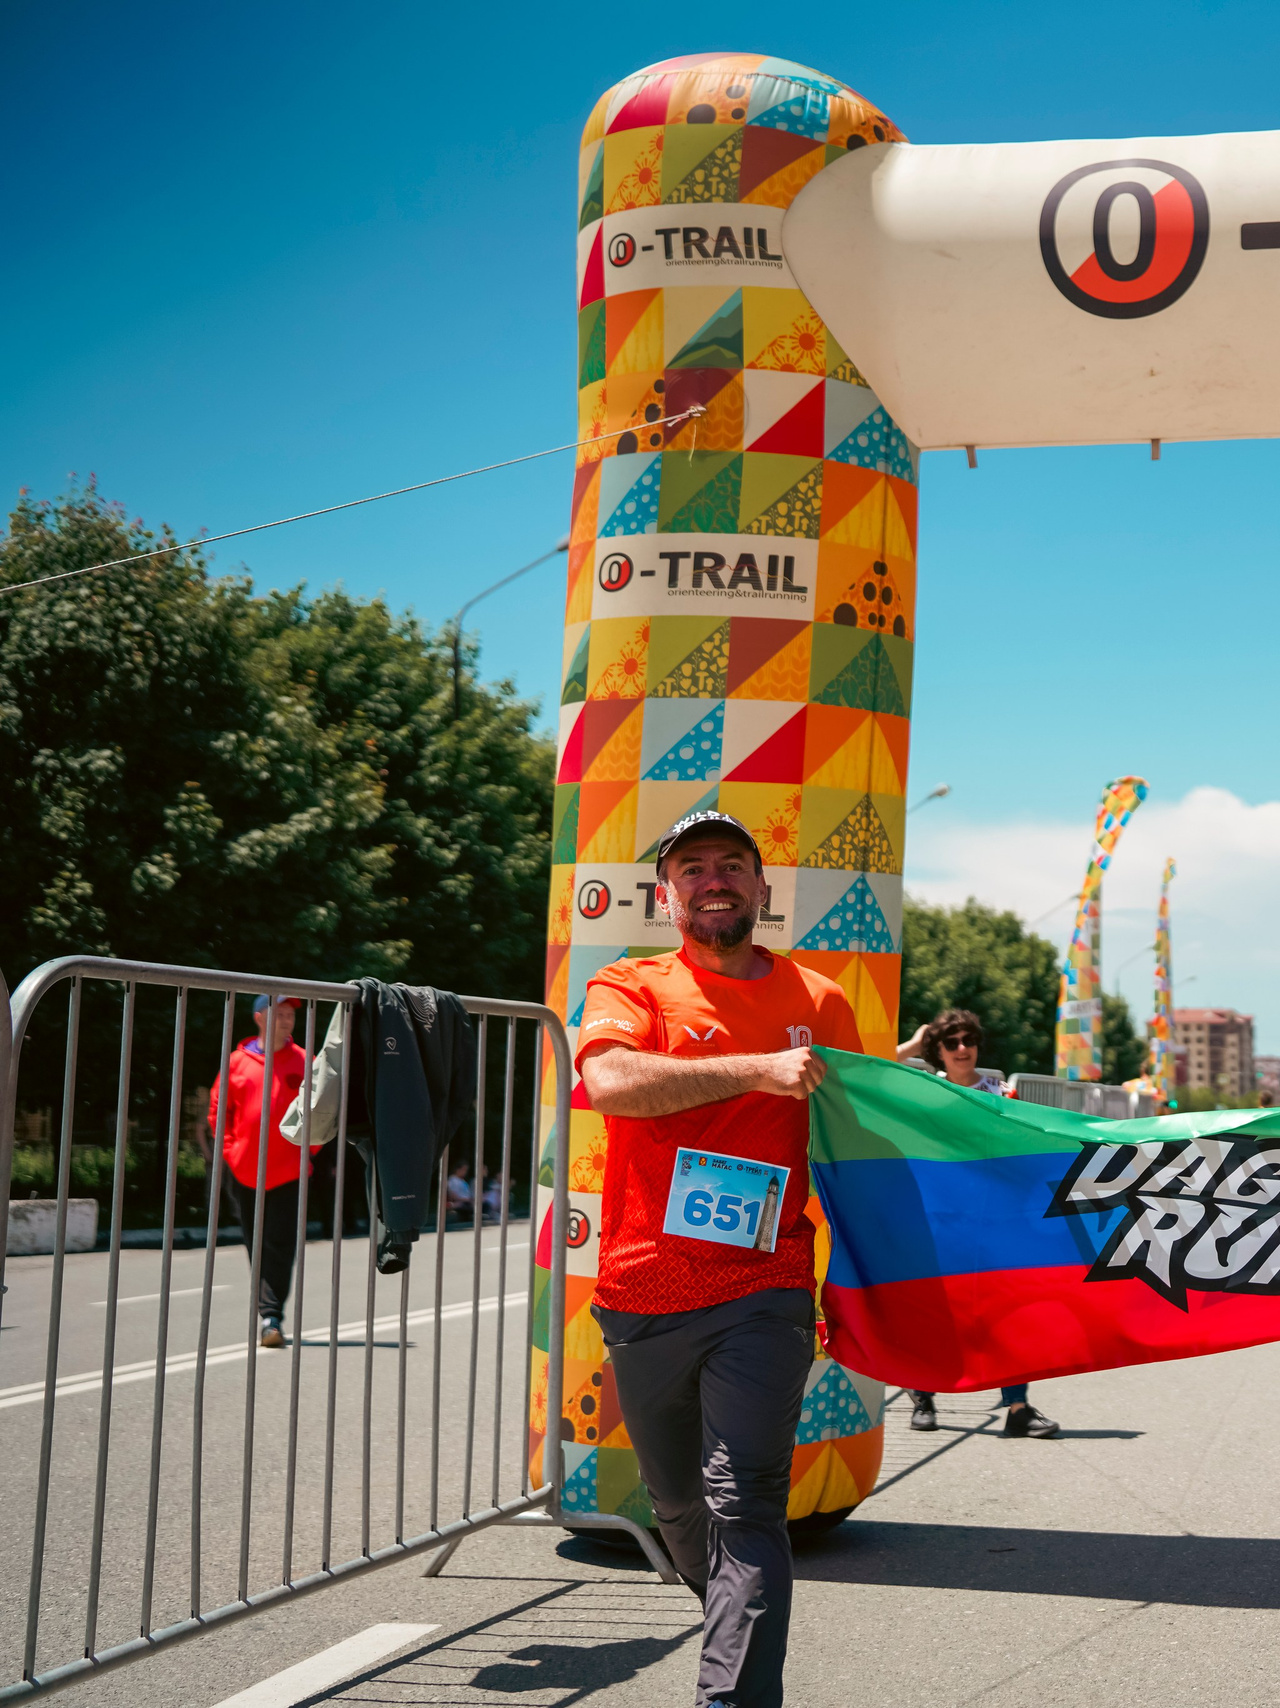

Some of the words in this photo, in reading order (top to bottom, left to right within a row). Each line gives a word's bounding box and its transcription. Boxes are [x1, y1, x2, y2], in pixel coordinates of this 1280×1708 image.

[665, 258, 783, 270] orienteering&trailrunning
[667, 587, 808, 604] orienteering&trailrunning
[683, 1189, 761, 1236] 651
